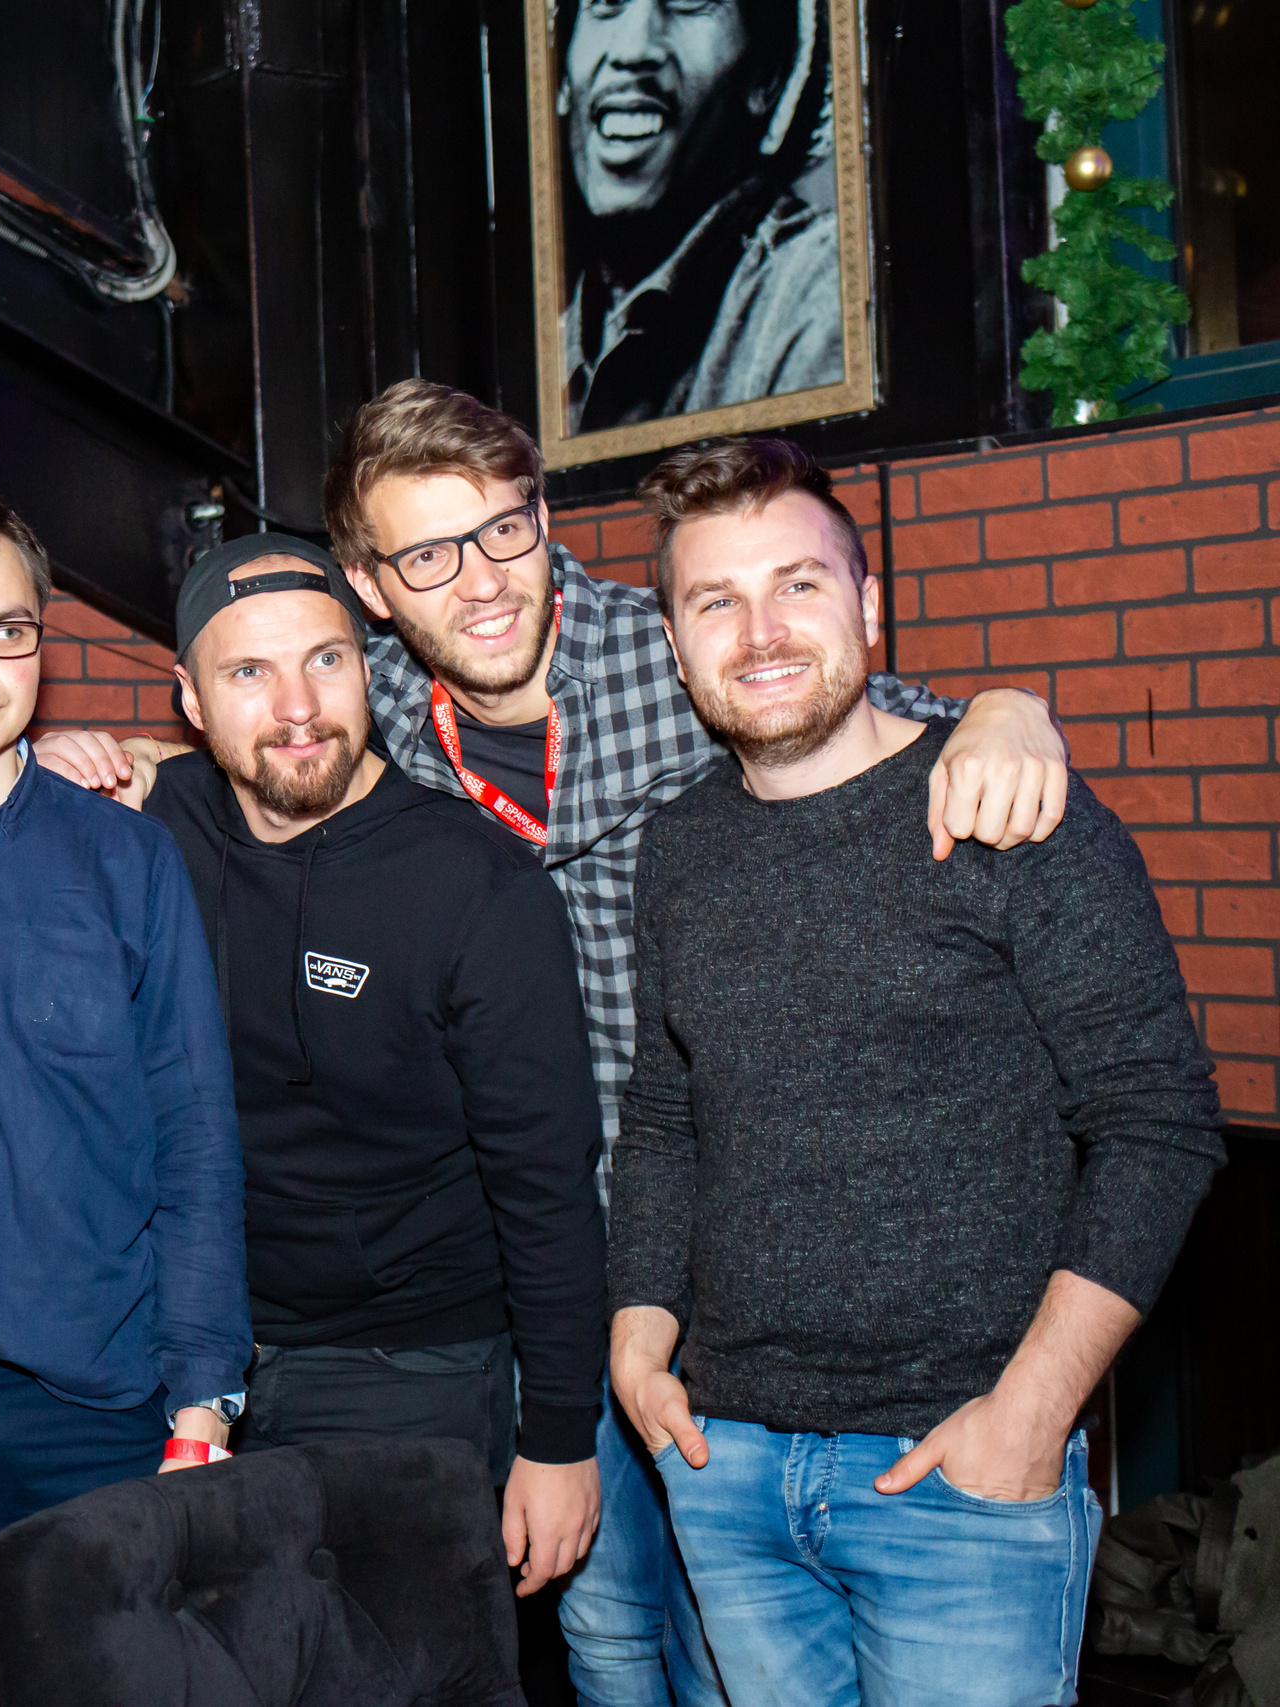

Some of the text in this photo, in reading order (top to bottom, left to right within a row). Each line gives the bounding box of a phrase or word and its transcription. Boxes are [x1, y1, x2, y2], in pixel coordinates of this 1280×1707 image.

[459, 772, 487, 793] ASSE
[505, 803, 548, 840] SPARKASS
[317, 959, 357, 981] VANS
